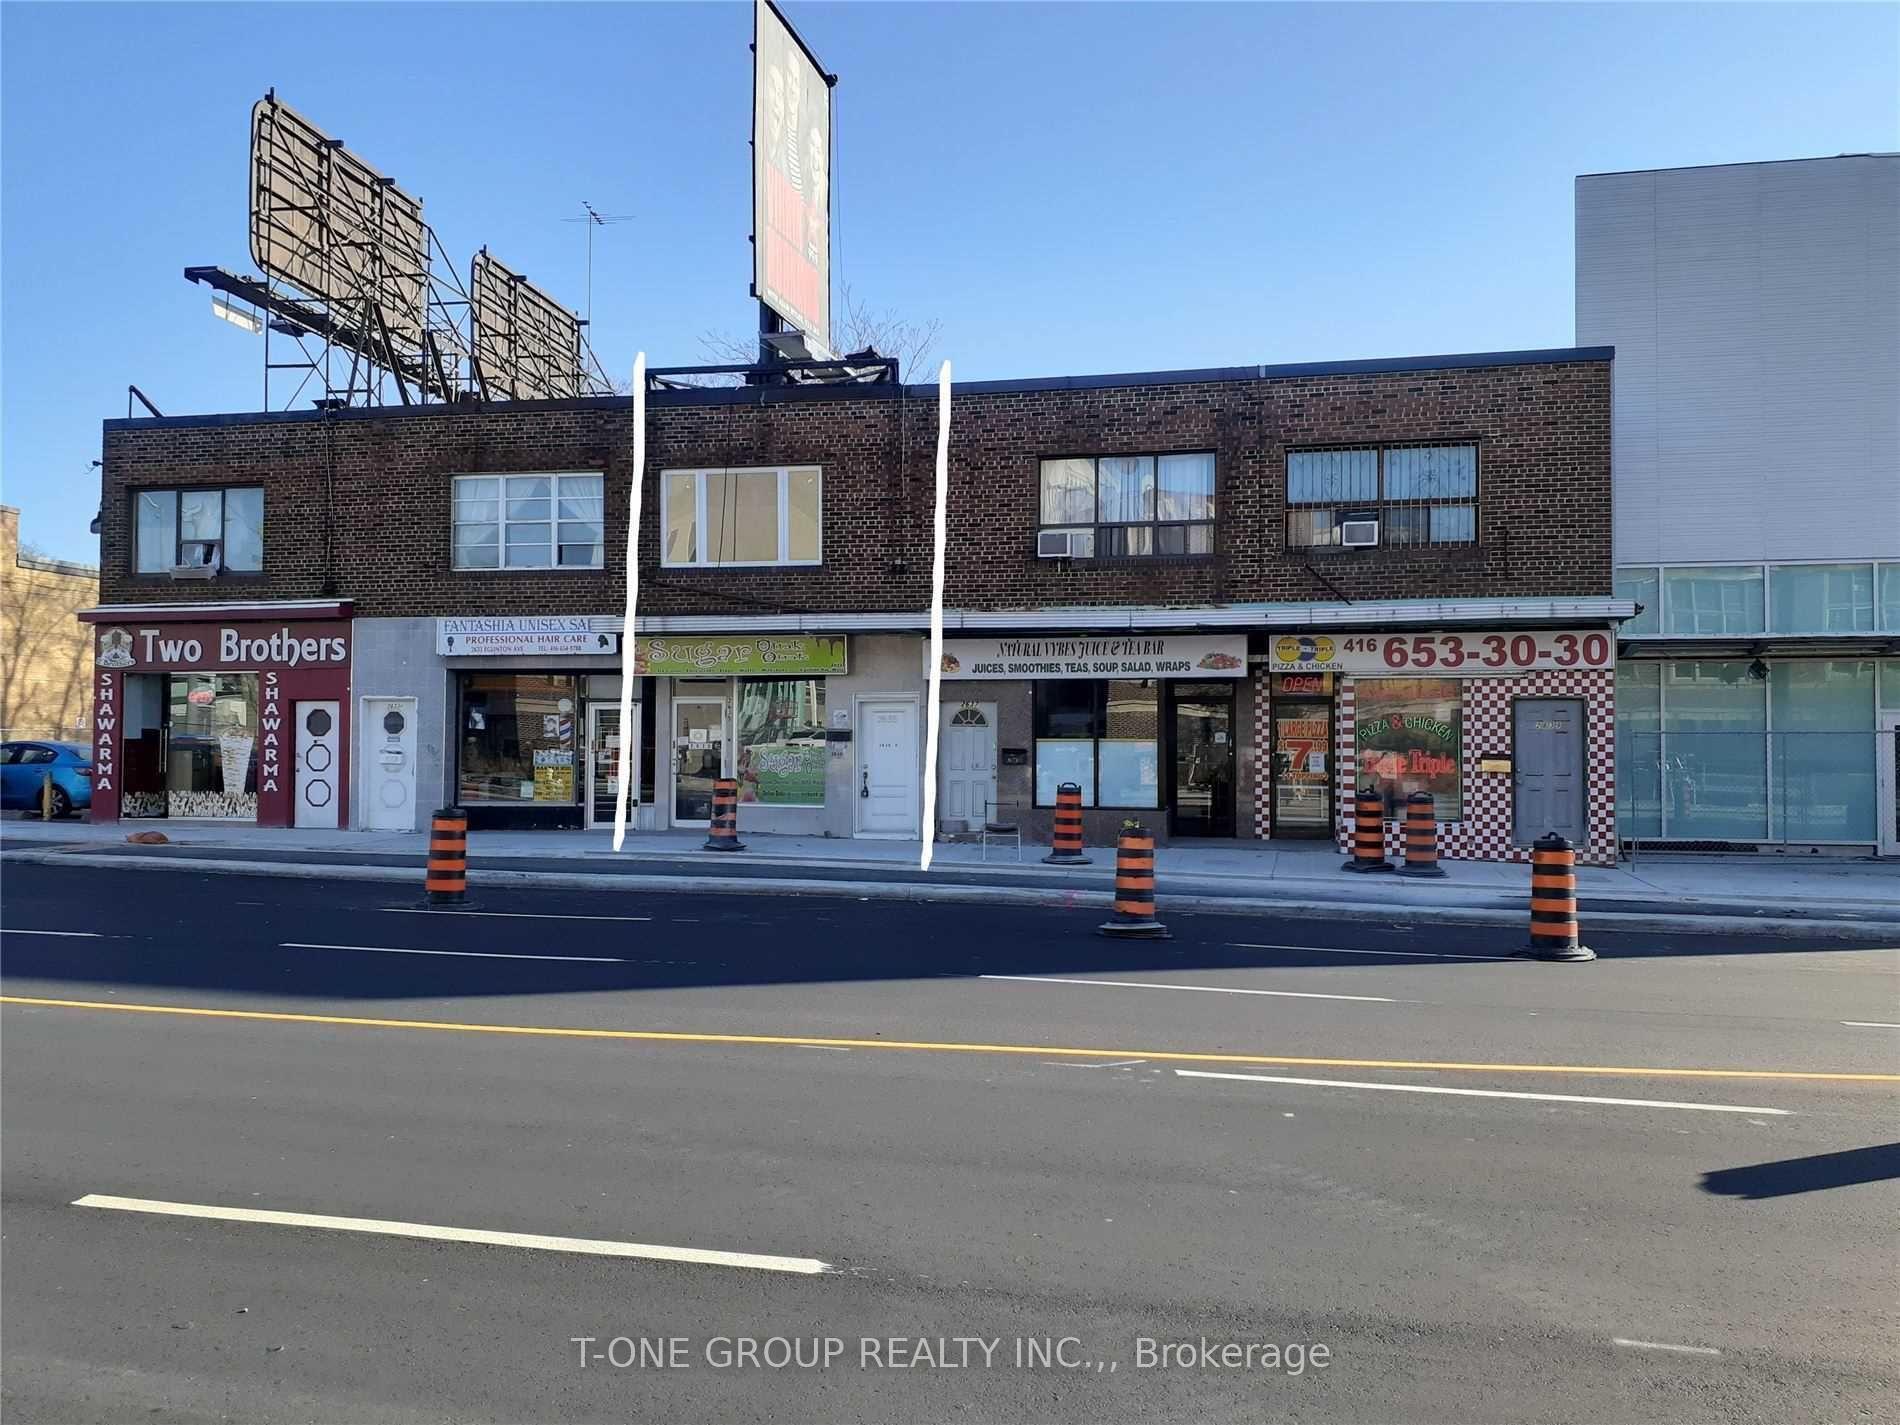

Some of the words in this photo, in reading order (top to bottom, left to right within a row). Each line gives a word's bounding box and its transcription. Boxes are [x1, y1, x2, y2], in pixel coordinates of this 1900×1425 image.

[444, 618, 515, 632] FANTASHIA
[519, 618, 565, 632] UNISEX
[139, 628, 202, 662] Two
[219, 627, 346, 667] Brothers
[465, 635, 534, 644] PROFESSIONAL
[537, 635, 560, 643] HAIR
[563, 634, 587, 643] CARE
[996, 639, 1042, 657] NATURAL
[1077, 640, 1110, 659] JUICE
[1122, 638, 1142, 655] TEA
[1144, 639, 1165, 655] BAR
[1343, 638, 1377, 652] 416
[1383, 634, 1609, 668] 653-30-30
[647, 638, 751, 668] Sugar
[1272, 663, 1296, 671] PIZZA
[1305, 662, 1343, 670] CHICKEN
[972, 663, 1007, 675] JUICES,
[1008, 662, 1063, 674] SMOOTHIES,
[1065, 662, 1091, 674] TEAS,
[1093, 661, 1119, 674] SOUP,
[1156, 661, 1191, 672] WRAPS
[1281, 676, 1321, 692] OPEN
[97, 673, 115, 790] SHAWARMA
[262, 672, 281, 792] SHAWARMA
[1359, 719, 1390, 741] PIZZA
[1392, 714, 1403, 730] &
[1405, 716, 1454, 741] CHICKEN
[1408, 748, 1456, 778] Triple
